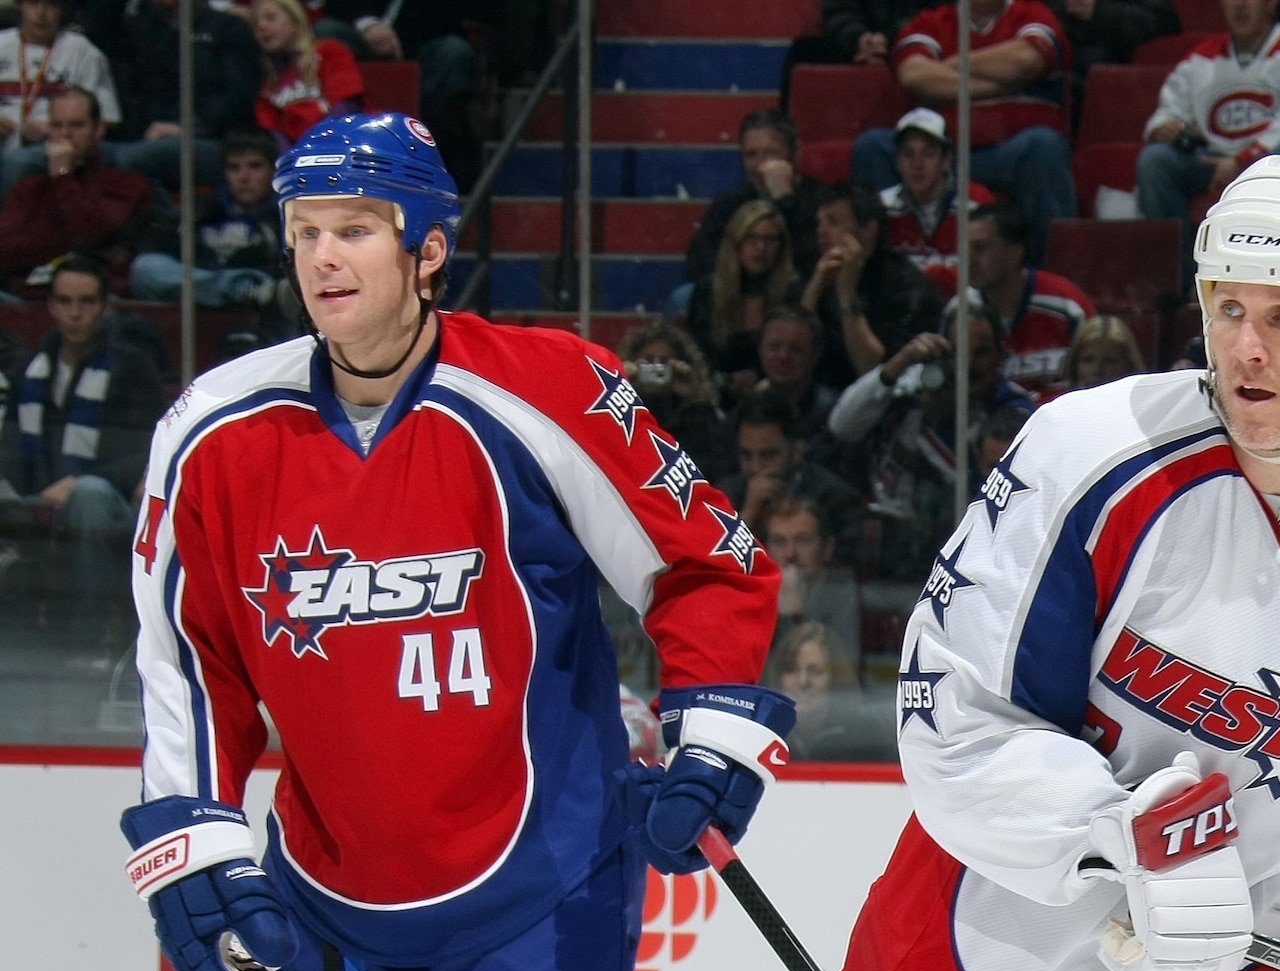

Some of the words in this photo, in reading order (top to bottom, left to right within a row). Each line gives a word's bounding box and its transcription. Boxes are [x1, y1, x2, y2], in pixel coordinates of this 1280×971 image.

[1003, 347, 1070, 378] AST
[980, 467, 1013, 509] 969
[726, 520, 756, 562] 199
[286, 553, 479, 620] EAST
[397, 627, 493, 712] 44
[708, 693, 756, 712] KOMISAREK
[1162, 797, 1237, 857] TPS
